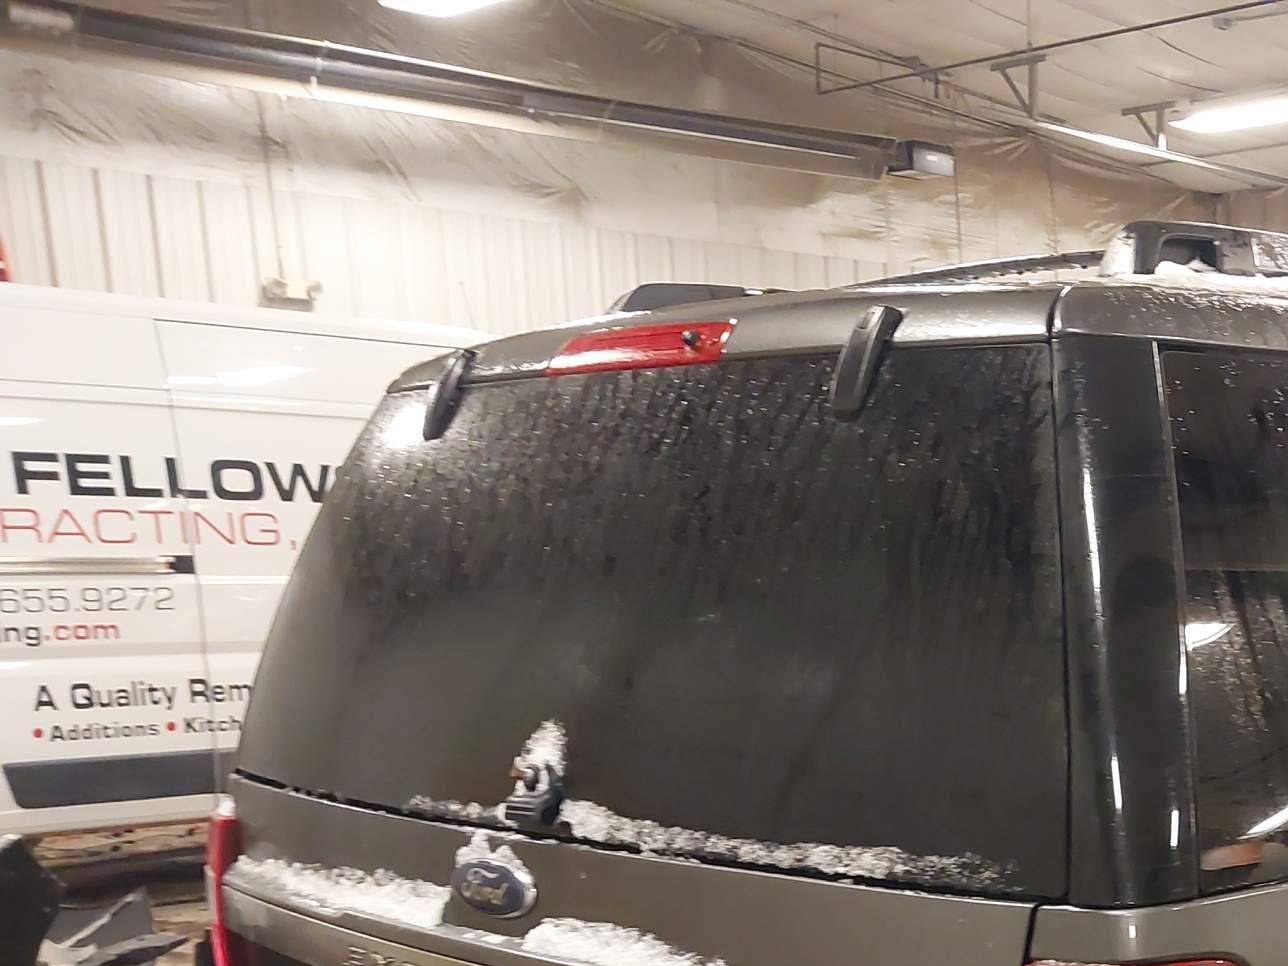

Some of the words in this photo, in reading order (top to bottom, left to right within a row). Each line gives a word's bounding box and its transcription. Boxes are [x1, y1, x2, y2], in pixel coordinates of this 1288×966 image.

[11, 451, 341, 502] FELLOW
[0, 507, 298, 550] RACTING,
[0, 586, 175, 613] 655.9272
[34, 684, 59, 711] A
[71, 680, 177, 710] Quality
[188, 678, 253, 704] Rem
[49, 721, 160, 742] Additions
[183, 715, 242, 734] Kitch
